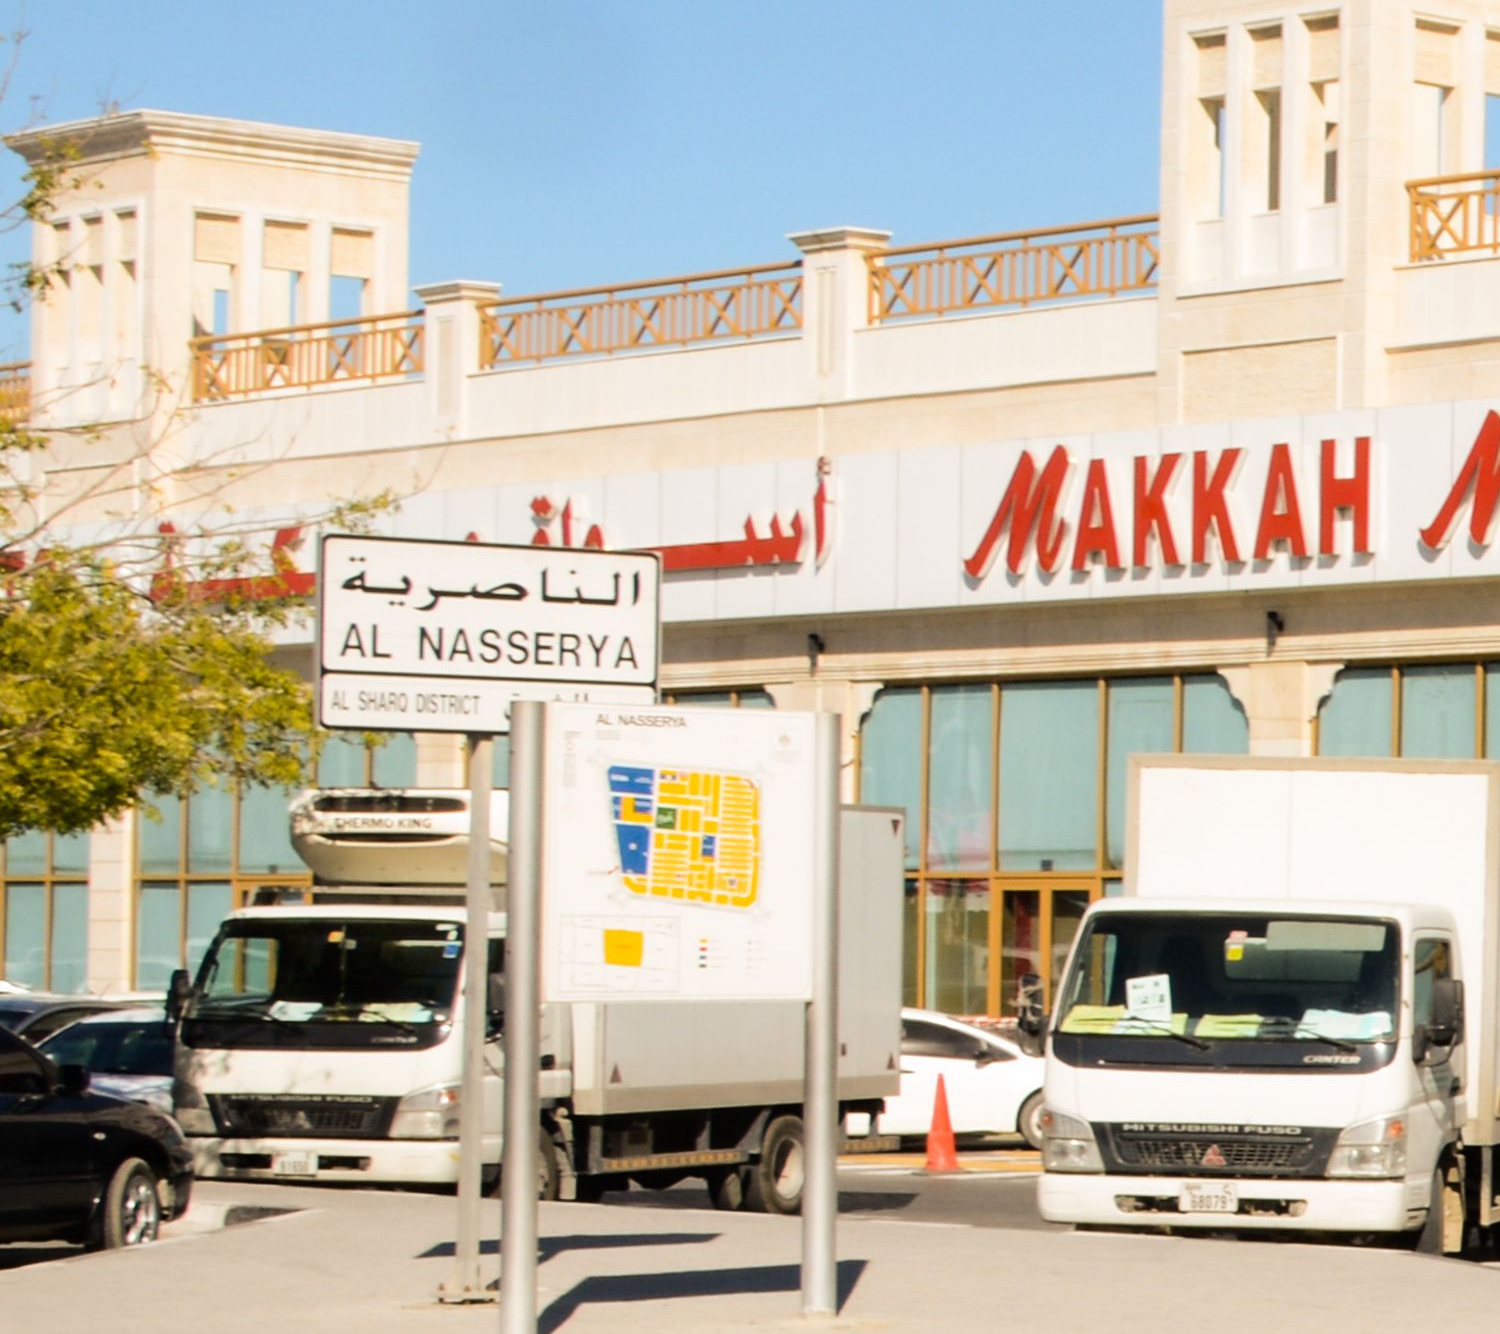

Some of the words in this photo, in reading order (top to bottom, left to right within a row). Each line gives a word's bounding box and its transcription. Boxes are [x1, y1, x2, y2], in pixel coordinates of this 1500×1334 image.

[965, 437, 1372, 578] MAKKAH
[340, 554, 641, 612] الناصرية
[339, 622, 393, 660] AL
[417, 625, 640, 670] NASSERYA
[330, 690, 350, 712] AL
[415, 692, 482, 716] DISTRICT
[595, 712, 614, 726] AL
[617, 714, 688, 729] NASSERYA
[397, 817, 433, 830] KING
[1121, 1122, 1240, 1135] MITSUBISHI
[1243, 1123, 1302, 1136] FUSO
